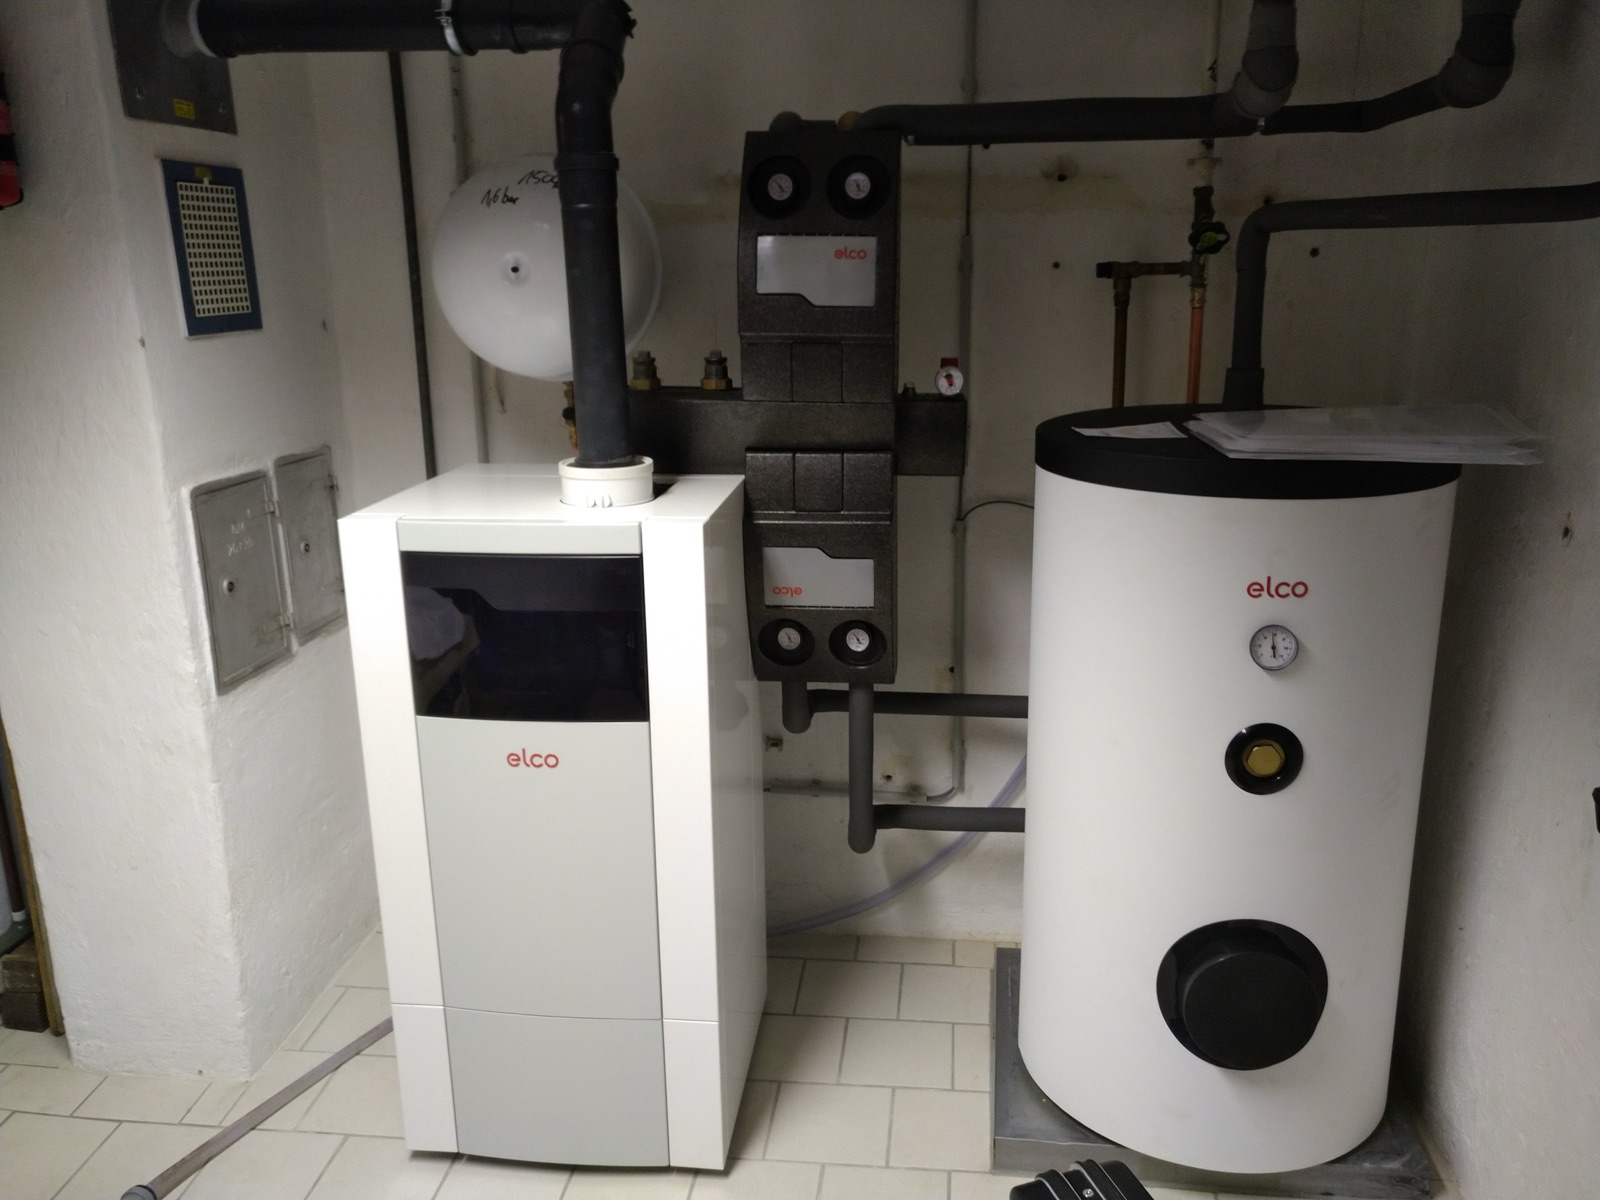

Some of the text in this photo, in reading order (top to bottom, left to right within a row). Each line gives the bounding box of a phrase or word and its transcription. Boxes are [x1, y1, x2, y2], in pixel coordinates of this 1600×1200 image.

[501, 185, 520, 205] bar
[834, 246, 867, 260] elco
[772, 586, 803, 598] elco
[1246, 575, 1309, 599] elco
[506, 748, 559, 768] elco
